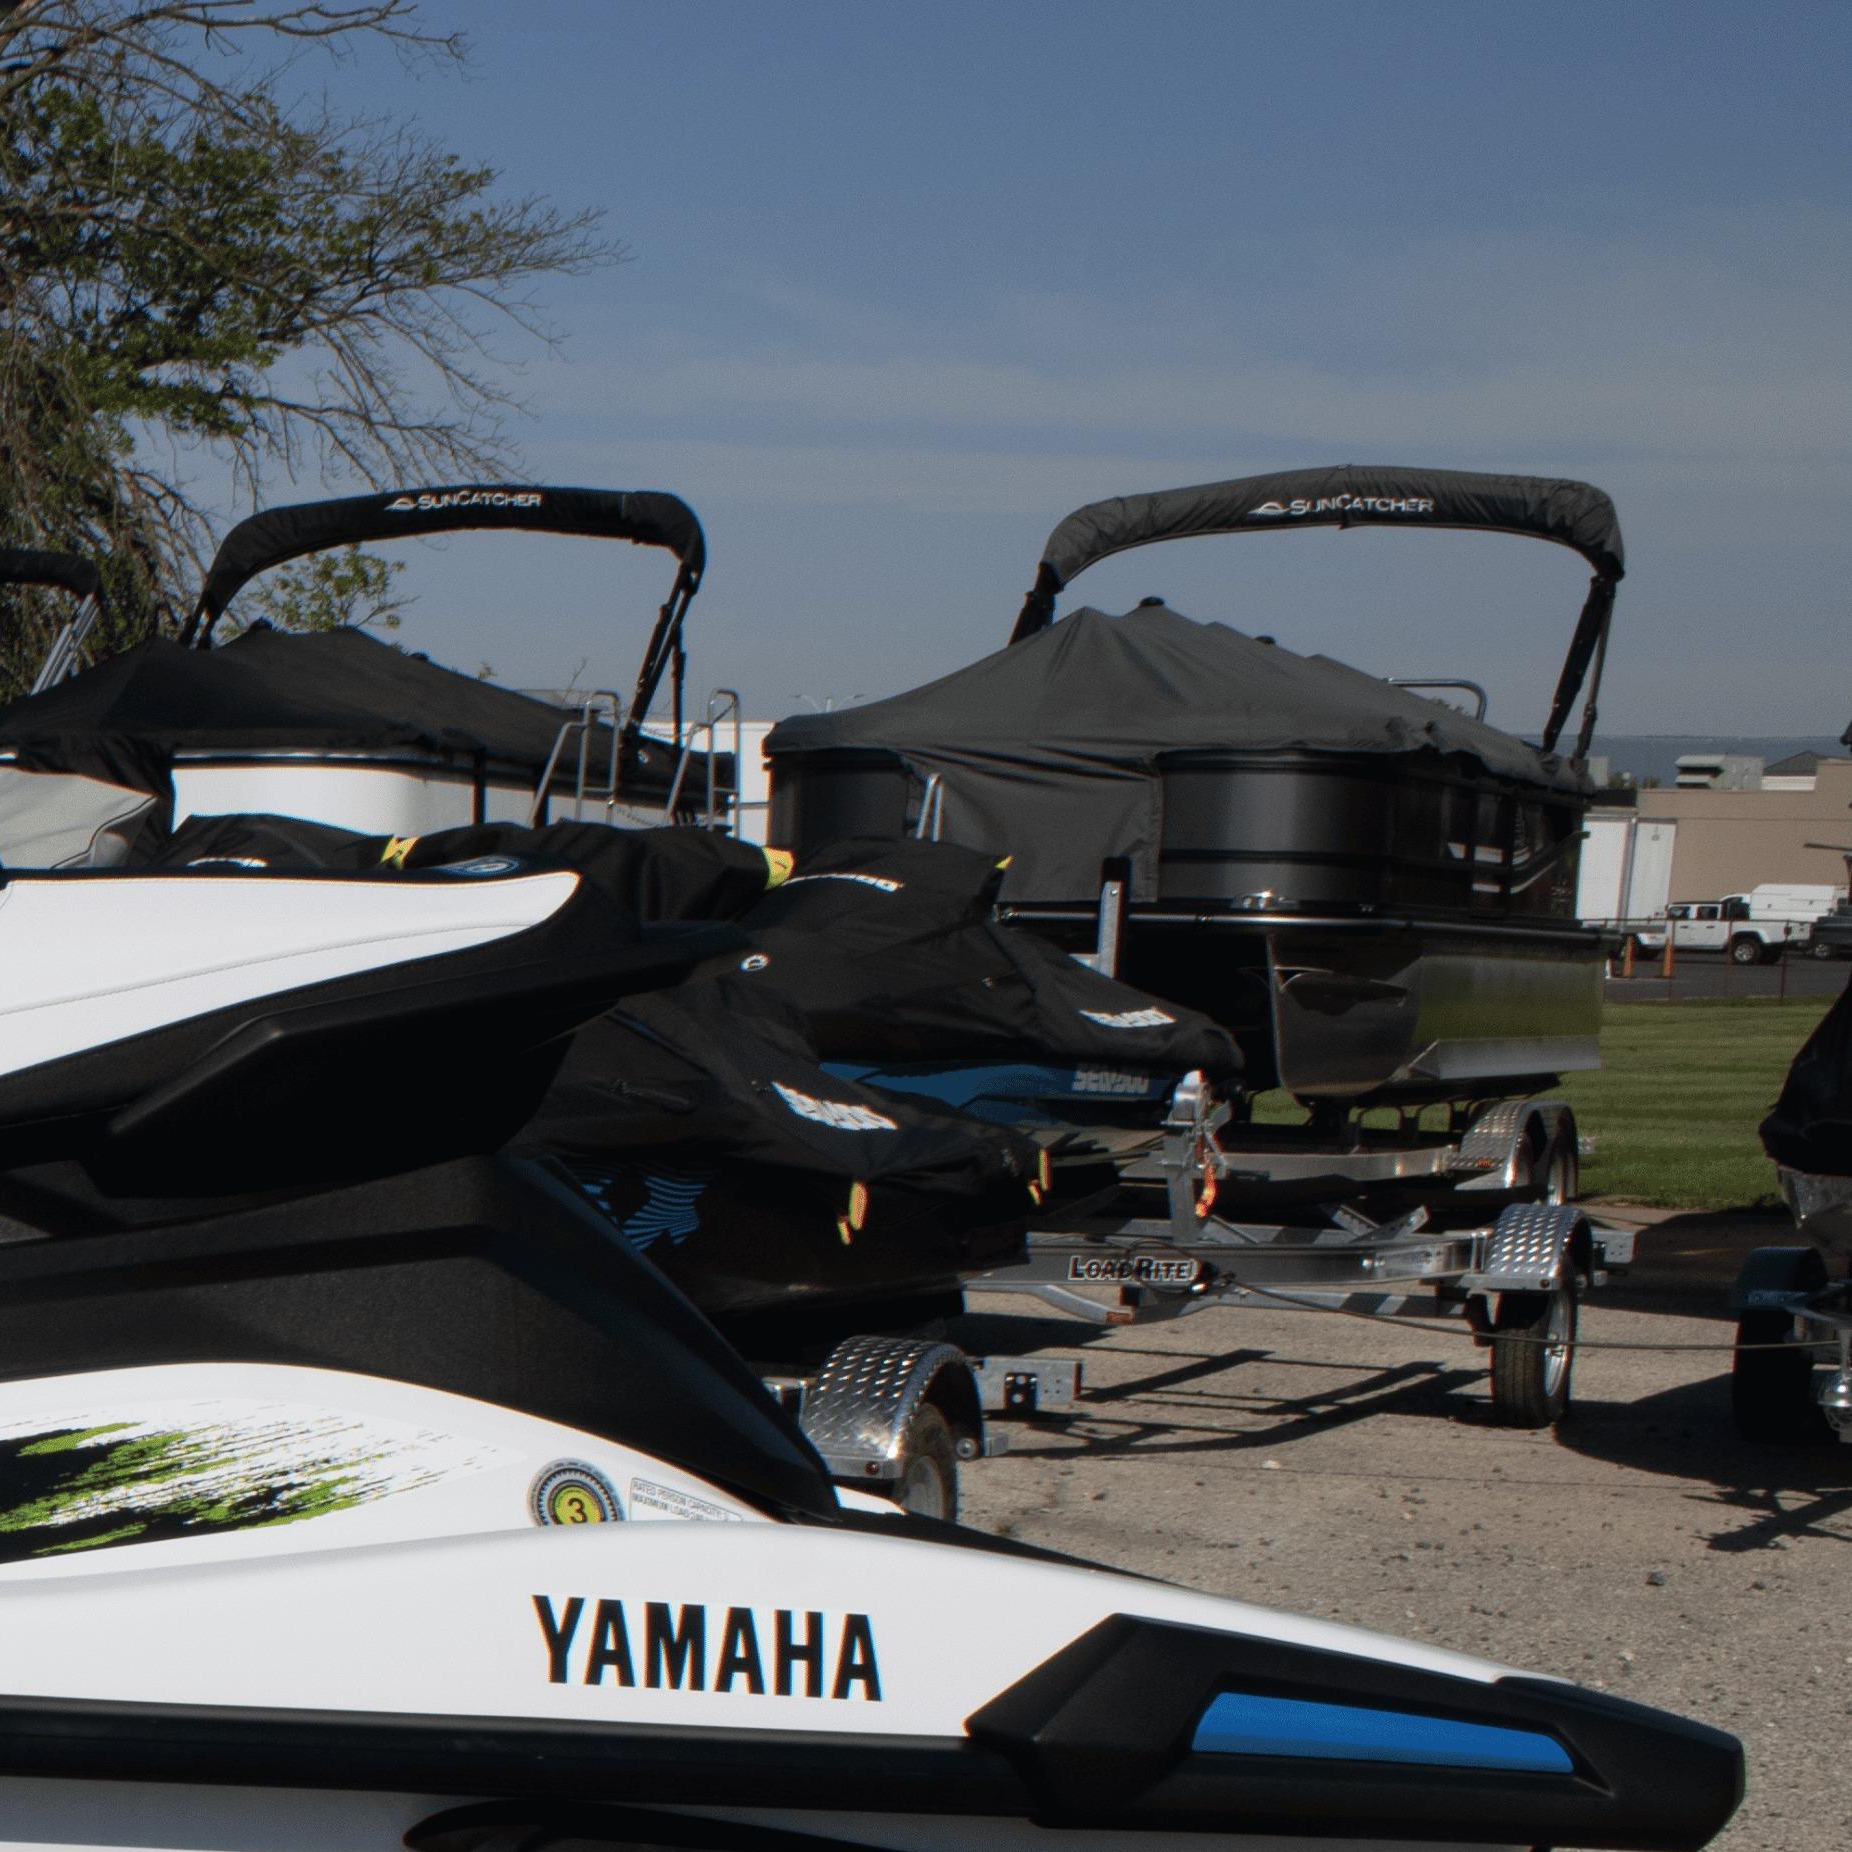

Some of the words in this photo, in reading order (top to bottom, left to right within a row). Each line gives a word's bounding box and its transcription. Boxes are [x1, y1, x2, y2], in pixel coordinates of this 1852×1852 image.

[418, 490, 541, 510] SUNCATCHER
[1290, 493, 1434, 515] SUNCATCHER
[567, 1497, 588, 1524] 3
[533, 1595, 883, 1702] YAMAHA
